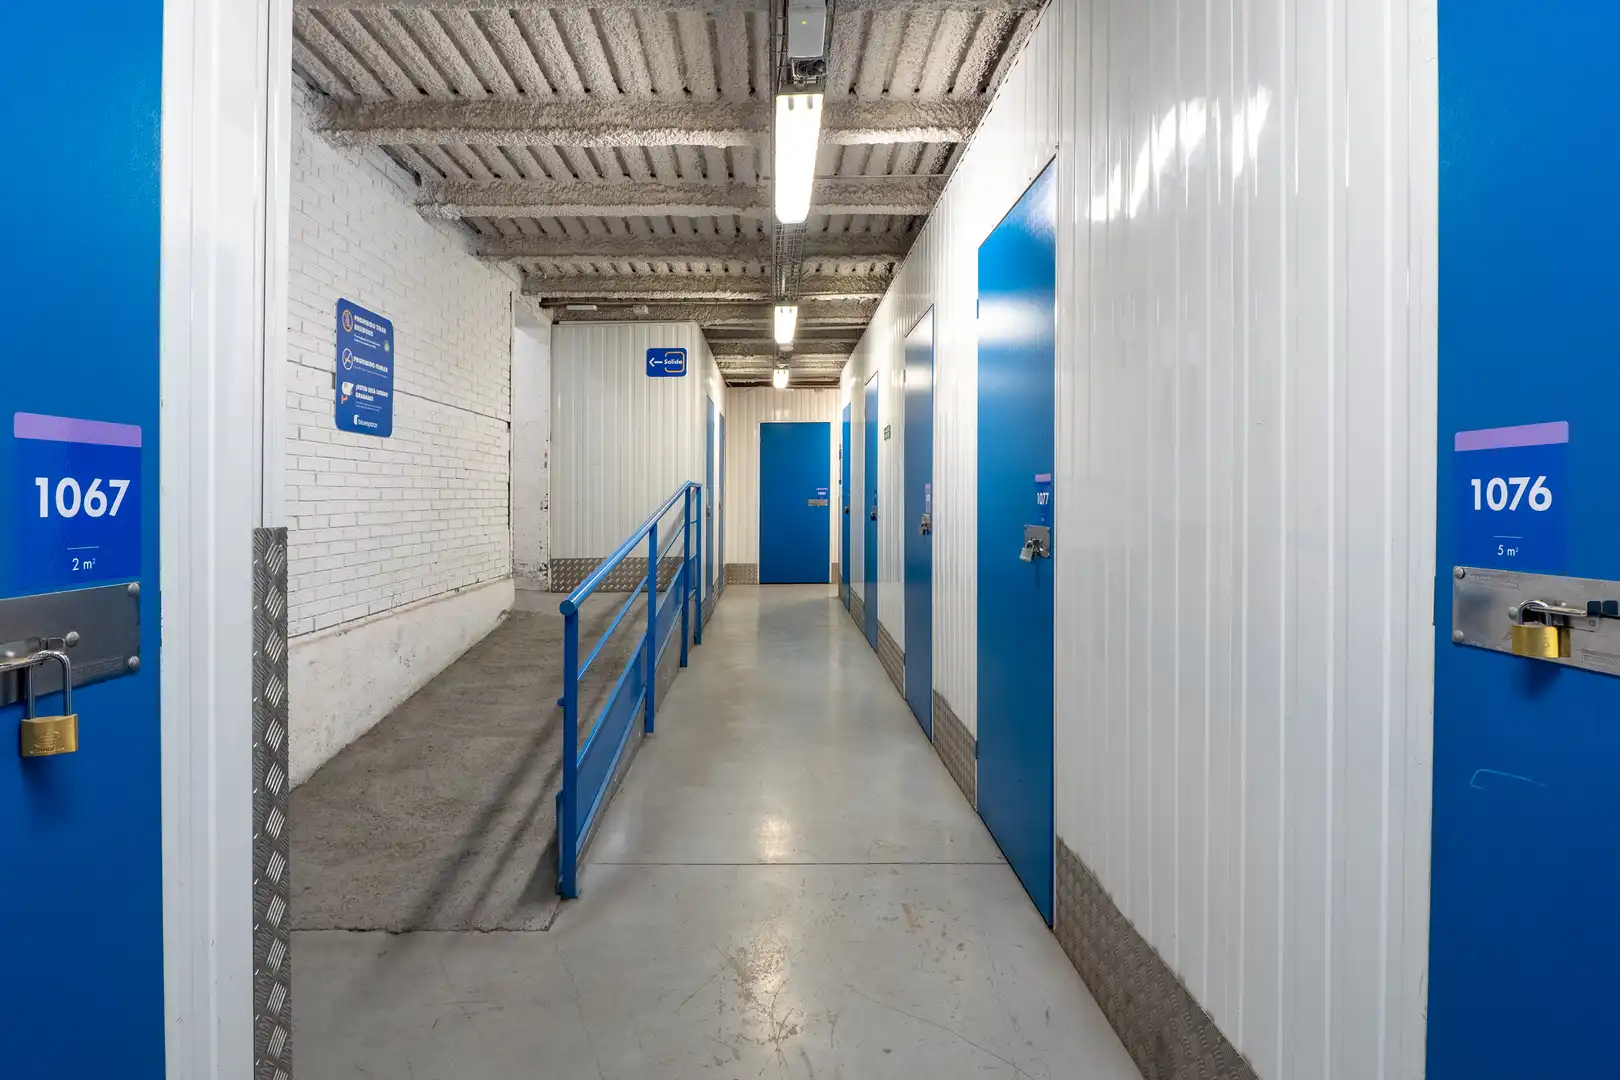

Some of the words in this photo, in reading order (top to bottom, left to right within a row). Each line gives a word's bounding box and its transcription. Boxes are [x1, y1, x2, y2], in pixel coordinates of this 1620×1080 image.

[35, 477, 131, 518] 1067
[1036, 492, 1050, 505] 1077
[1471, 475, 1553, 511] 1076
[1497, 544, 1504, 556] 5
[72, 557, 80, 571] 2
